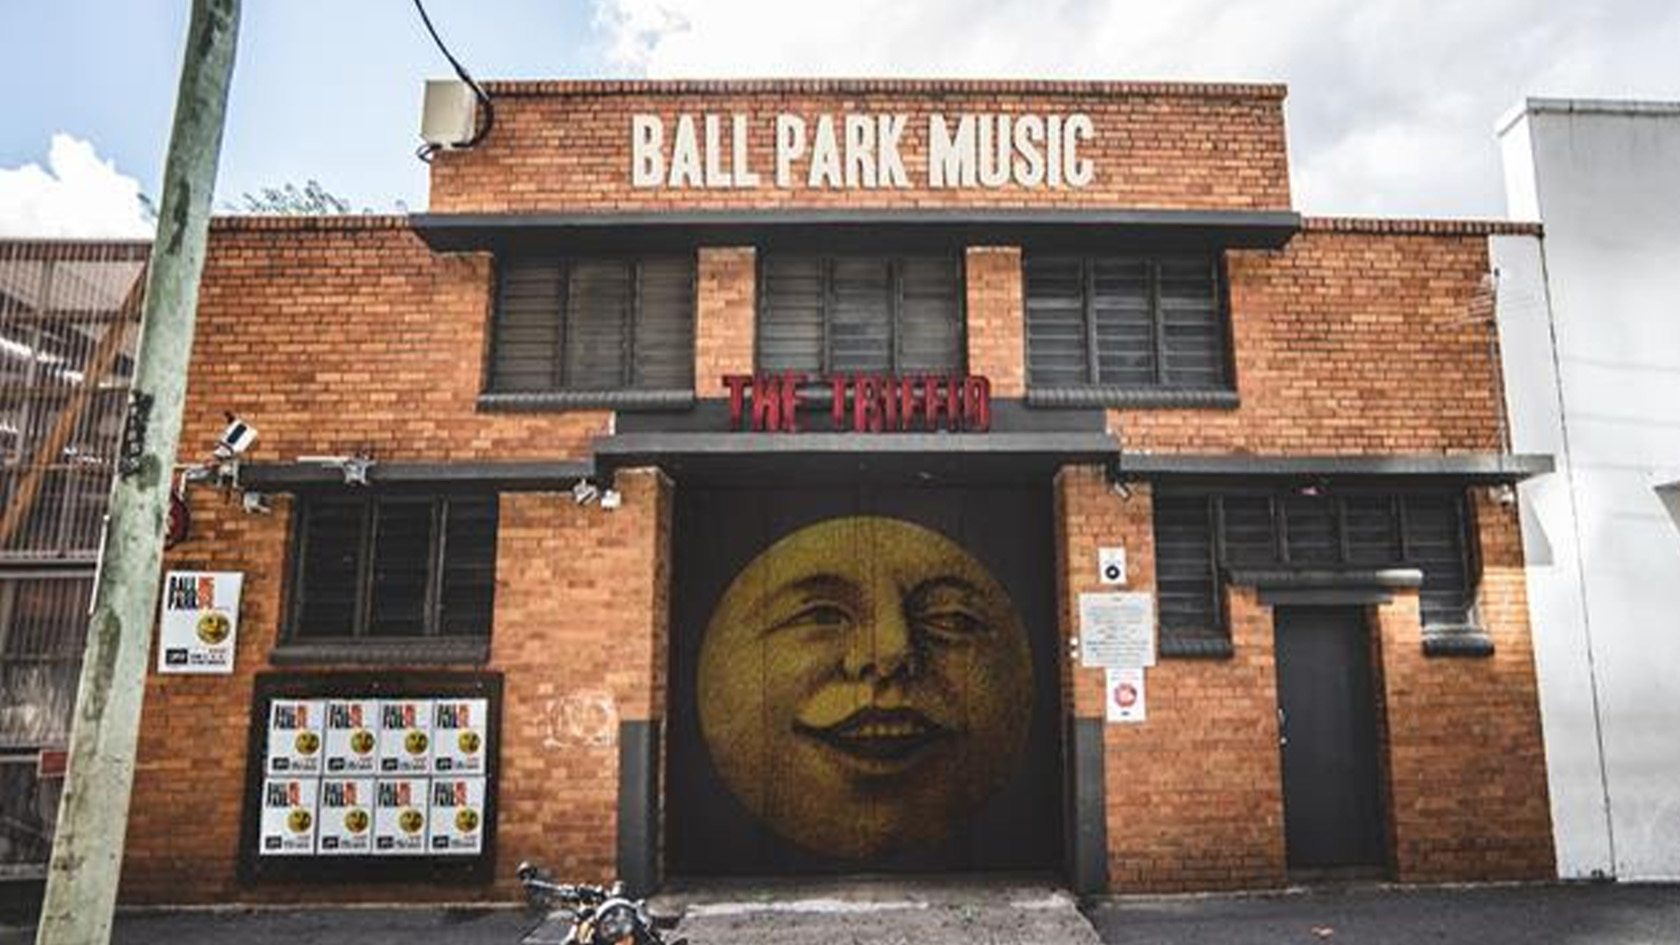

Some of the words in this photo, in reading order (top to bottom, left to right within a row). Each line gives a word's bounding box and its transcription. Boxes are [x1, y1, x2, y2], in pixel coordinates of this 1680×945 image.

[631, 113, 761, 188] BALL
[775, 113, 913, 188] PARK
[927, 112, 1095, 188] MUSIC
[722, 372, 810, 433] THE
[826, 372, 991, 433] TRIFFID
